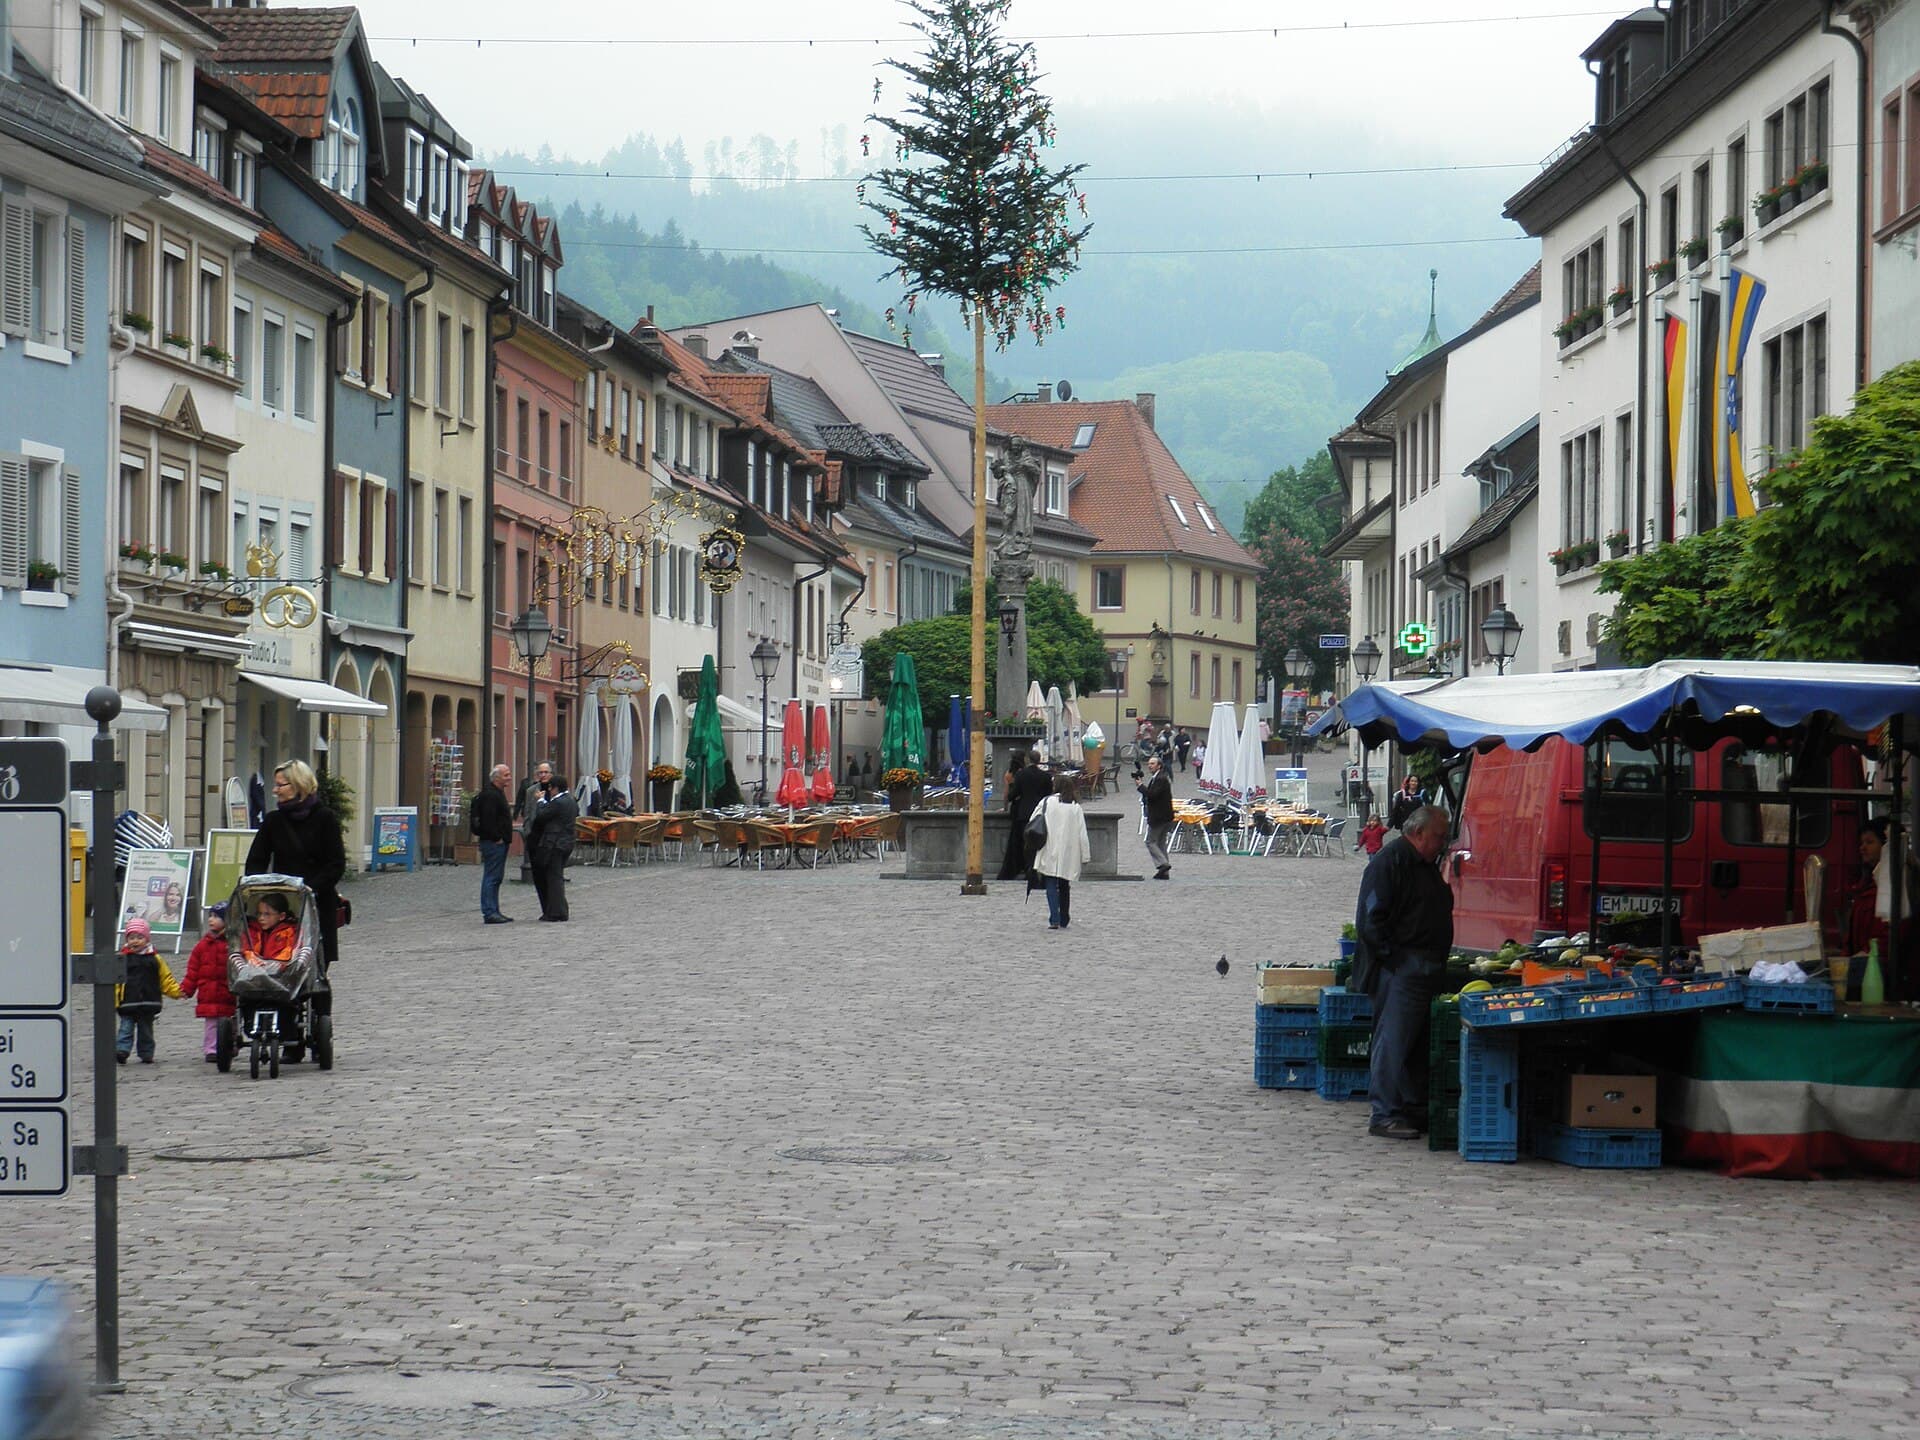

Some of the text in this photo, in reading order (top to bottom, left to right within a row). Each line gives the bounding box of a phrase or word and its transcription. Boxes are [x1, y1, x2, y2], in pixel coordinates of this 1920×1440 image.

[1602, 897, 1621, 913] EM
[1652, 899, 1678, 914] 99
[11, 1064, 36, 1089] Sa
[14, 1121, 39, 1146] Sa
[16, 1156, 27, 1181] h
